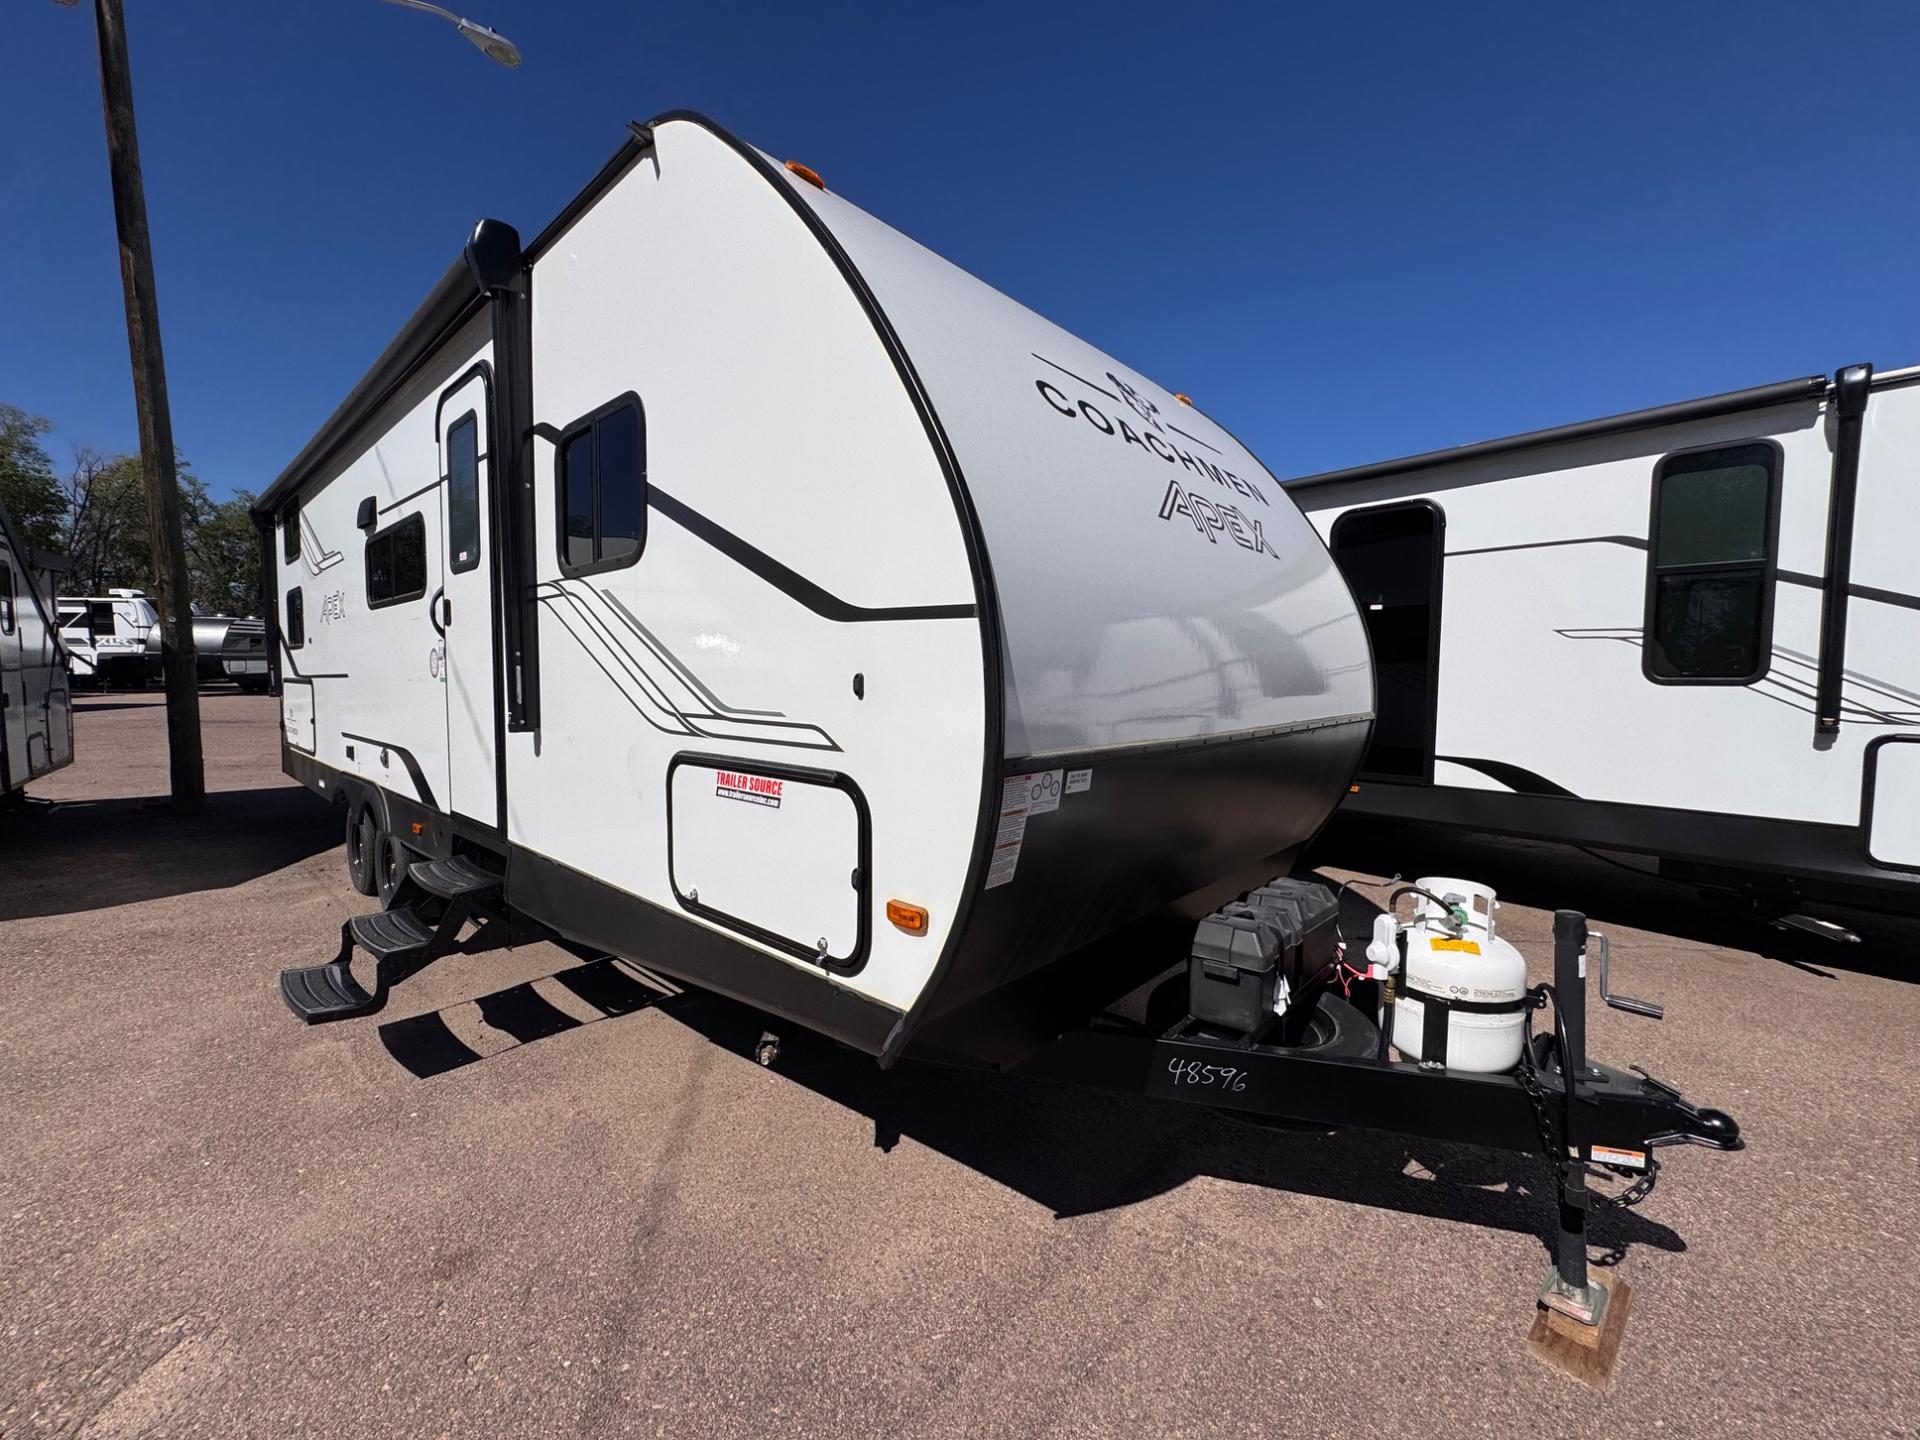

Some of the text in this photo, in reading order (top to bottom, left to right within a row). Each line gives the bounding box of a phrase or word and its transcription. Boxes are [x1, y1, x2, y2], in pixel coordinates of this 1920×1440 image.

[1035, 379, 1270, 506] COACHMEN
[1158, 480, 1280, 559] APEX
[320, 590, 346, 625] APEX
[716, 772, 783, 796] TRAILER SOURCE
[1168, 1058, 1247, 1092] 48596
